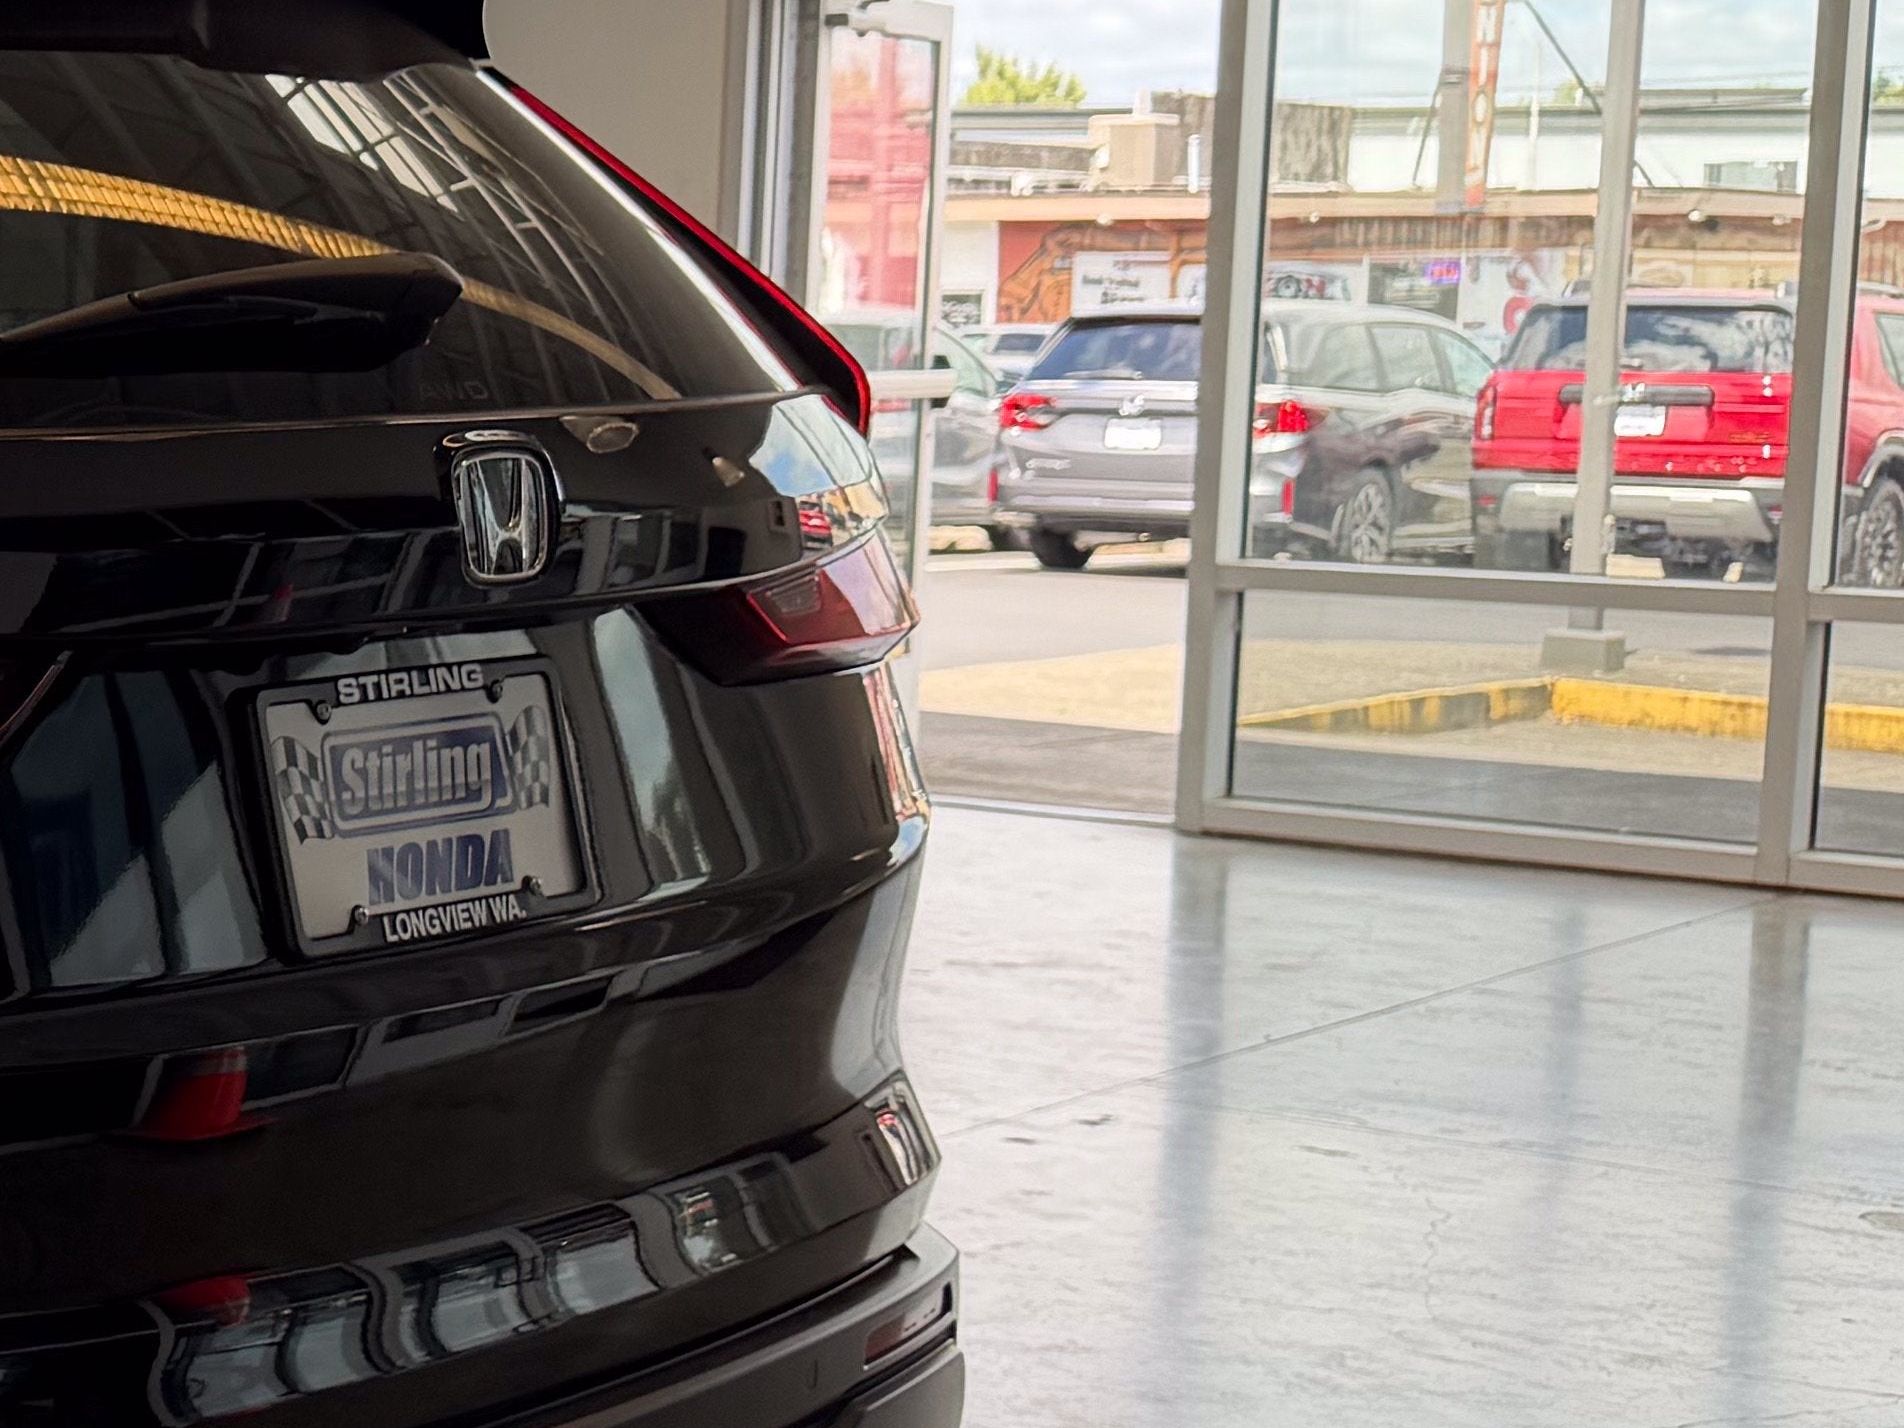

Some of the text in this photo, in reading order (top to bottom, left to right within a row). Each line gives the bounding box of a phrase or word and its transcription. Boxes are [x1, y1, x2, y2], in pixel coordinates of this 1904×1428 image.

[337, 663, 485, 705] STIRLING
[340, 735, 493, 817] Stirling
[366, 828, 515, 907] HONDA
[382, 893, 528, 943] LONGVIEW WA.
